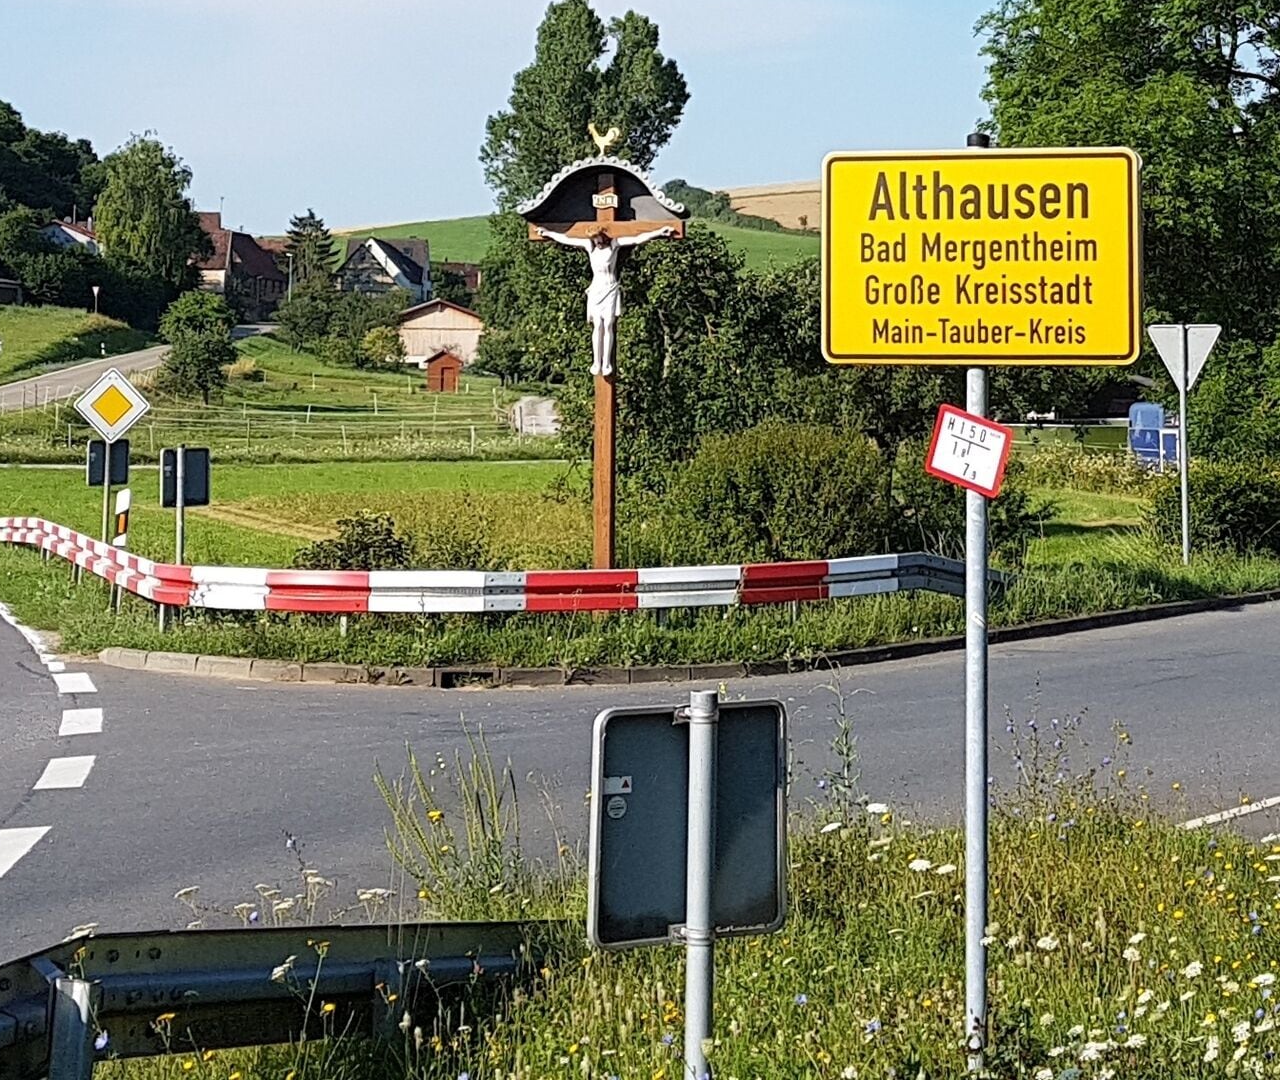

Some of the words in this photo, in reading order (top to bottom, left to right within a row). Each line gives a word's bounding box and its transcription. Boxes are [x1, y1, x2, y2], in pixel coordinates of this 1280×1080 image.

[868, 170, 1089, 221] Althausen
[860, 232, 906, 263] Bad
[921, 231, 1098, 271] Mergentheim
[865, 274, 941, 305] Große
[956, 273, 1093, 305] Kreisstadt
[872, 317, 1087, 345] Main-Tauber-Kreis
